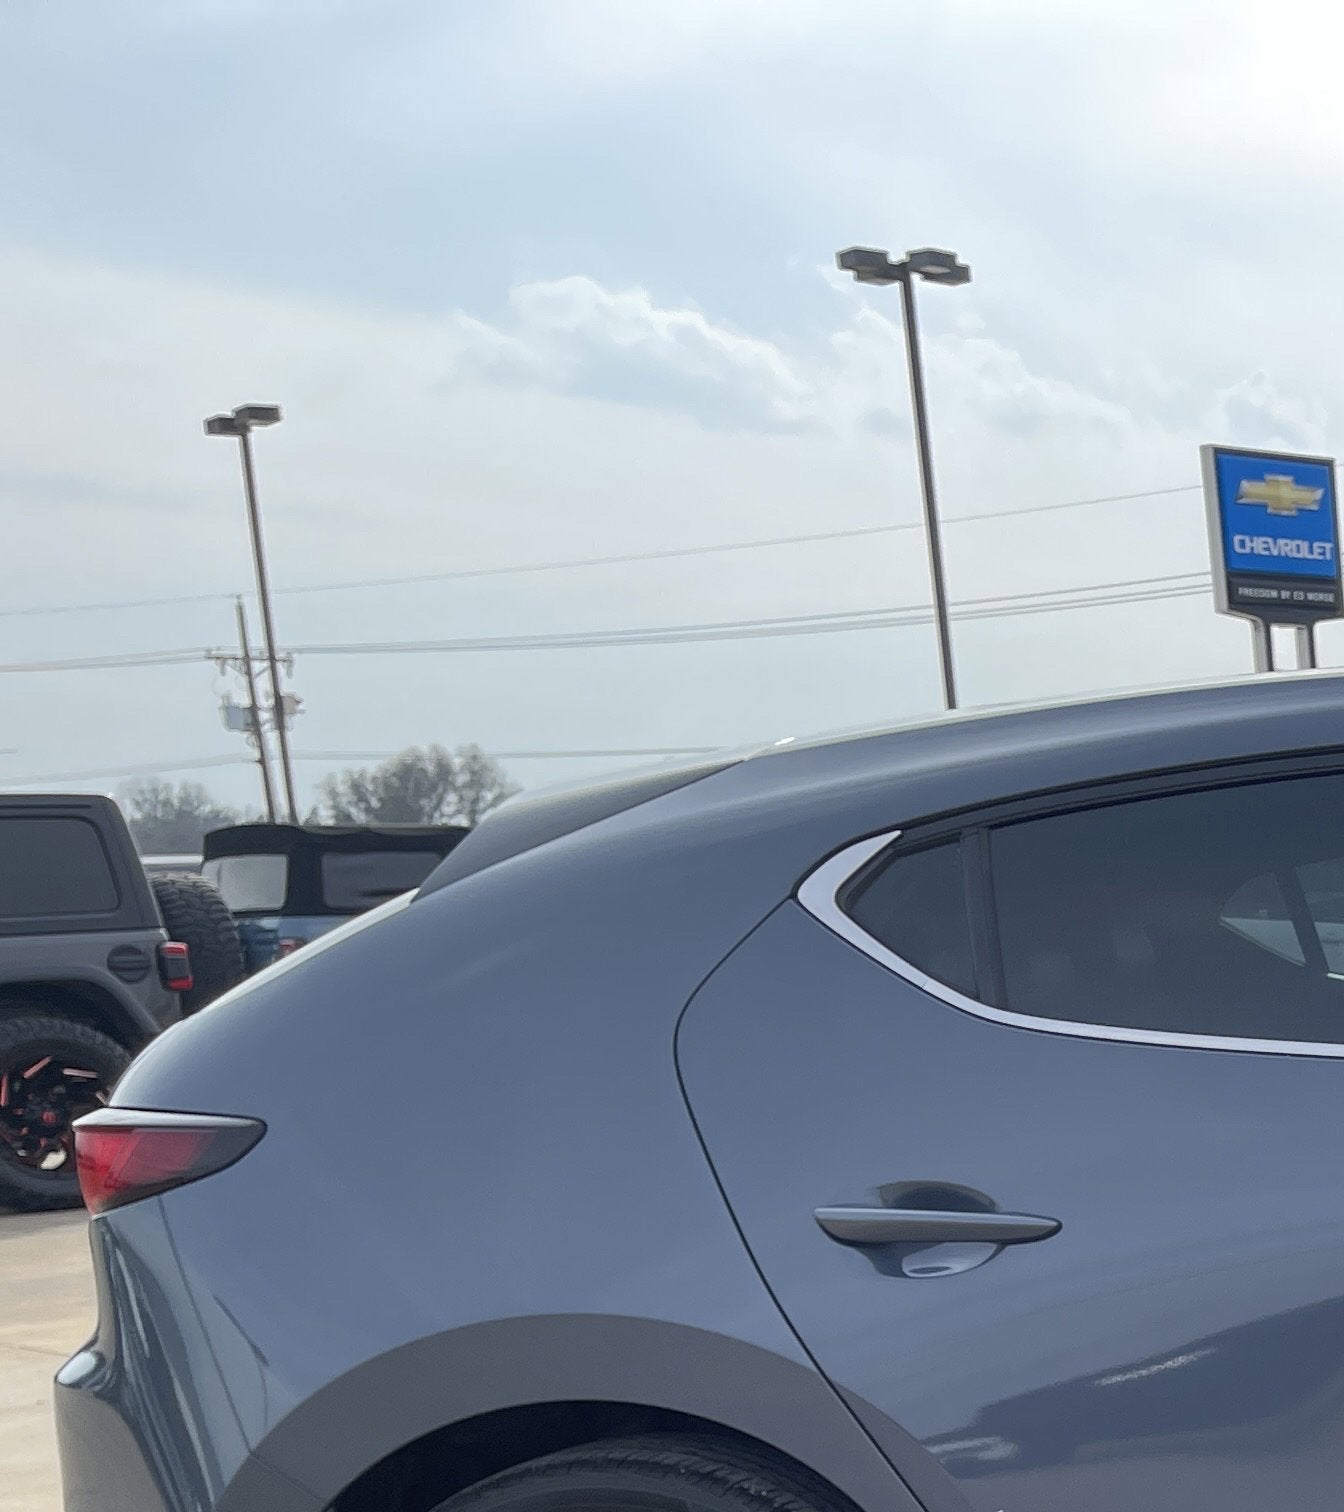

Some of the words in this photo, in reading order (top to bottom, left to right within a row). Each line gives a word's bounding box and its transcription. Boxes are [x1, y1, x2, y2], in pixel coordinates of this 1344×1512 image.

[1233, 534, 1334, 561] CHEVROLET
[1238, 587, 1278, 598] FREEDOM
[1280, 590, 1291, 600] BY
